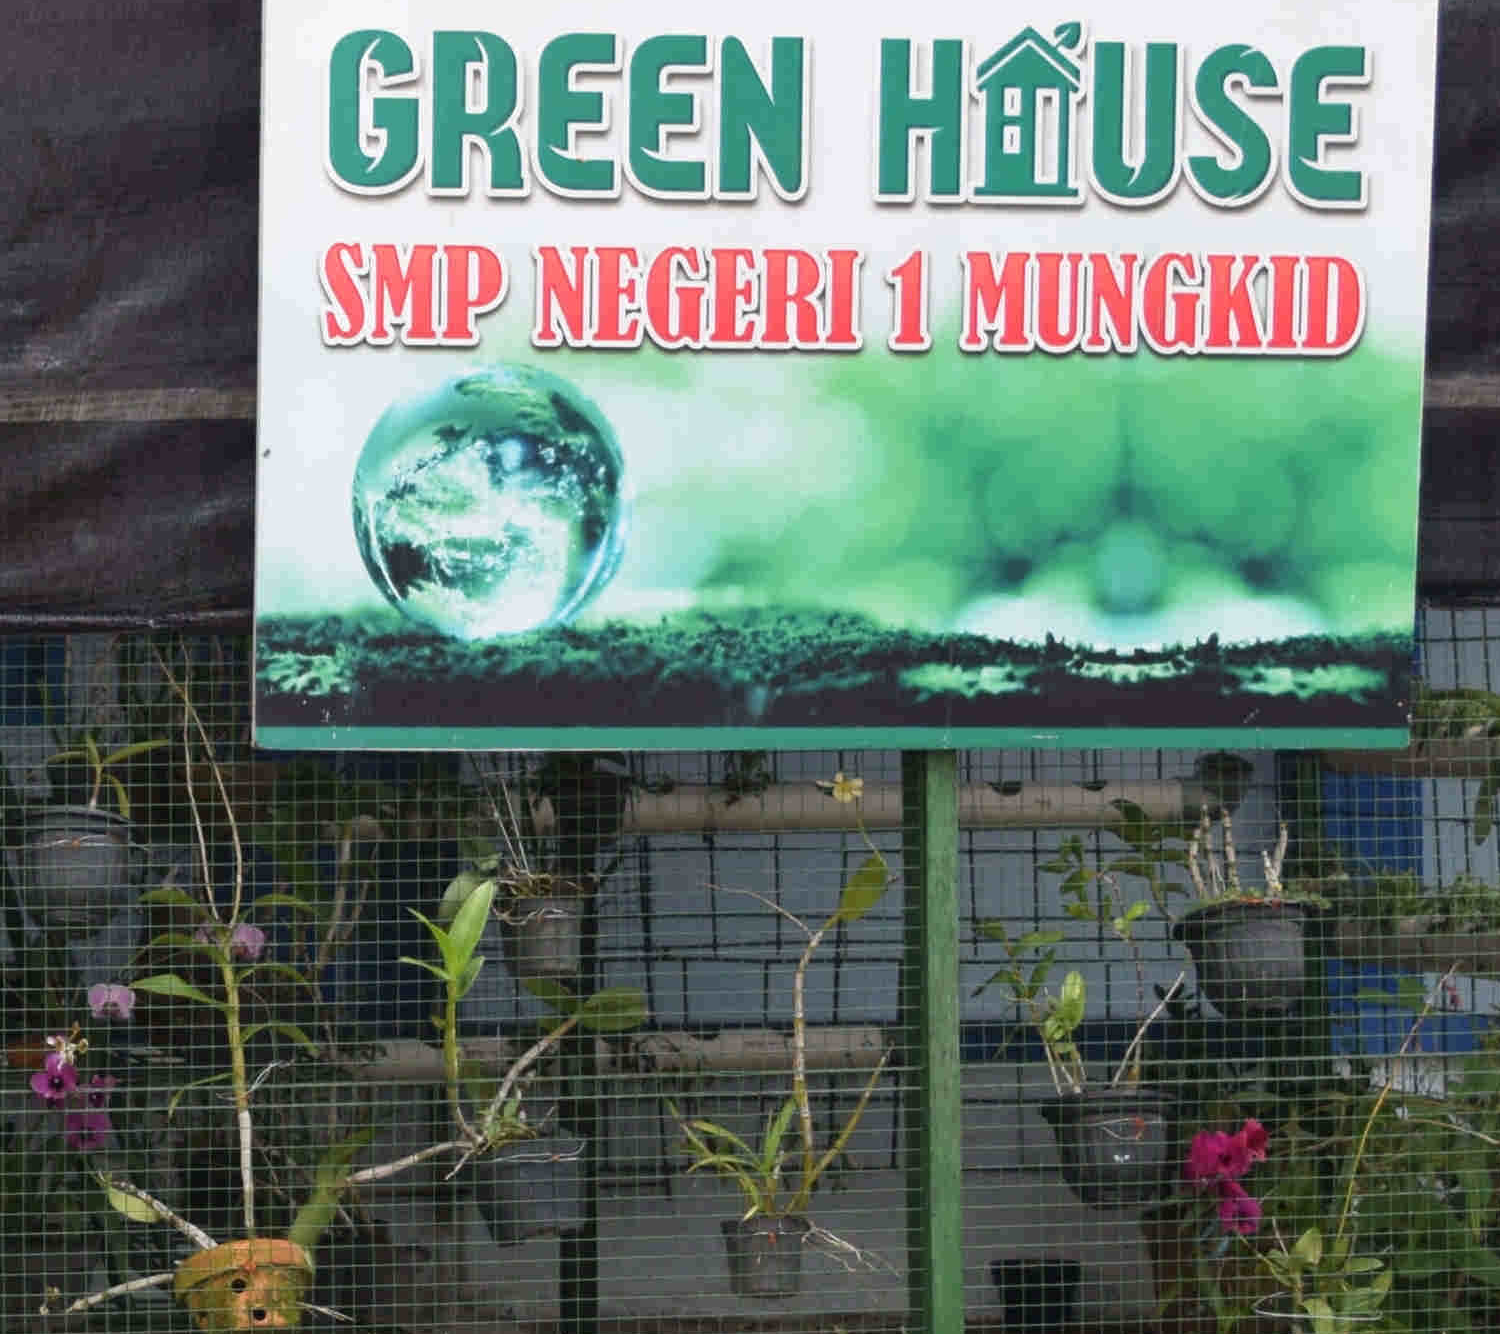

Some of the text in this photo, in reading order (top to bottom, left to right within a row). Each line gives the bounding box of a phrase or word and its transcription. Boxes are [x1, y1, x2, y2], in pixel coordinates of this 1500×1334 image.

[327, 23, 1365, 201] GREEN HUSE
[323, 241, 1362, 349] SMP NEGERI 1 MUNGKID
